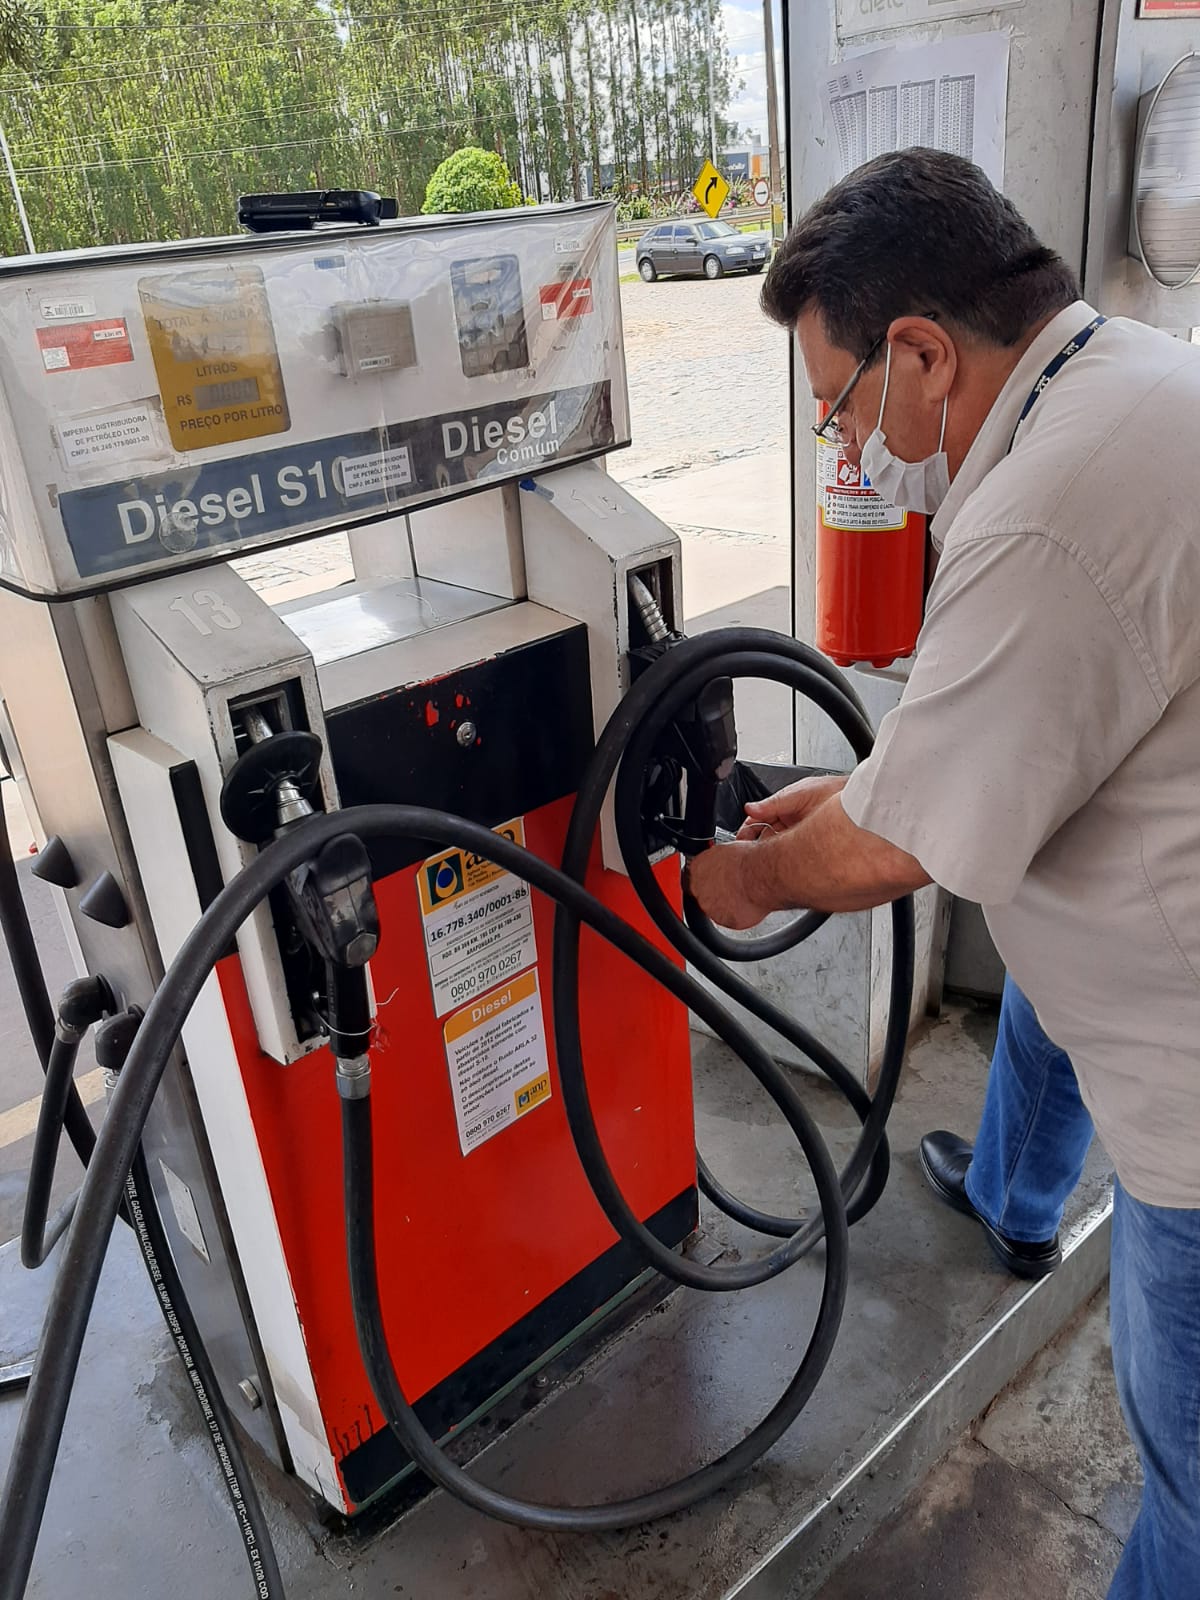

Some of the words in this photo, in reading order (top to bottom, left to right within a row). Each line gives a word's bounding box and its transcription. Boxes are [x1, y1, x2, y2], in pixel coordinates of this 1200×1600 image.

[196, 361, 238, 377] LITROS
[176, 394, 193, 407] R$
[62, 426, 95, 438] IMPERIAL
[95, 415, 147, 430] DISTRIBUIDORA
[180, 413, 221, 432] PREÇO
[224, 409, 249, 423] POR
[250, 404, 283, 419] LITRO
[441, 400, 558, 459] Diesel
[75, 438, 85, 446] DE
[86, 430, 122, 445] PETRÓLEO
[123, 427, 140, 436] LTDA
[496, 438, 560, 465] Comum
[117, 474, 265, 545] Diesel
[169, 588, 243, 636] 13
[450, 976, 476, 998] 0800
[478, 964, 497, 982] 970
[498, 949, 522, 971] 0267
[471, 989, 512, 1023] Diesel
[484, 1025, 501, 1038] diesel
[501, 1008, 530, 1029] fabricados
[514, 1024, 527, 1035] com
[530, 1079, 547, 1096] anp
[465, 1123, 482, 1138] 0800
[482, 1114, 495, 1127] 970
[131, 1200, 162, 1283] GASOLINA/ALCOOL/DIESEL
[175, 1335, 195, 1369] PORTARIA
[212, 1432, 222, 1444] DE
[228, 1476, 242, 1500] (TEMP
[250, 1548, 260, 1561] EX
[253, 1560, 265, 1582] 01/20
[258, 1581, 269, 1600] COD
